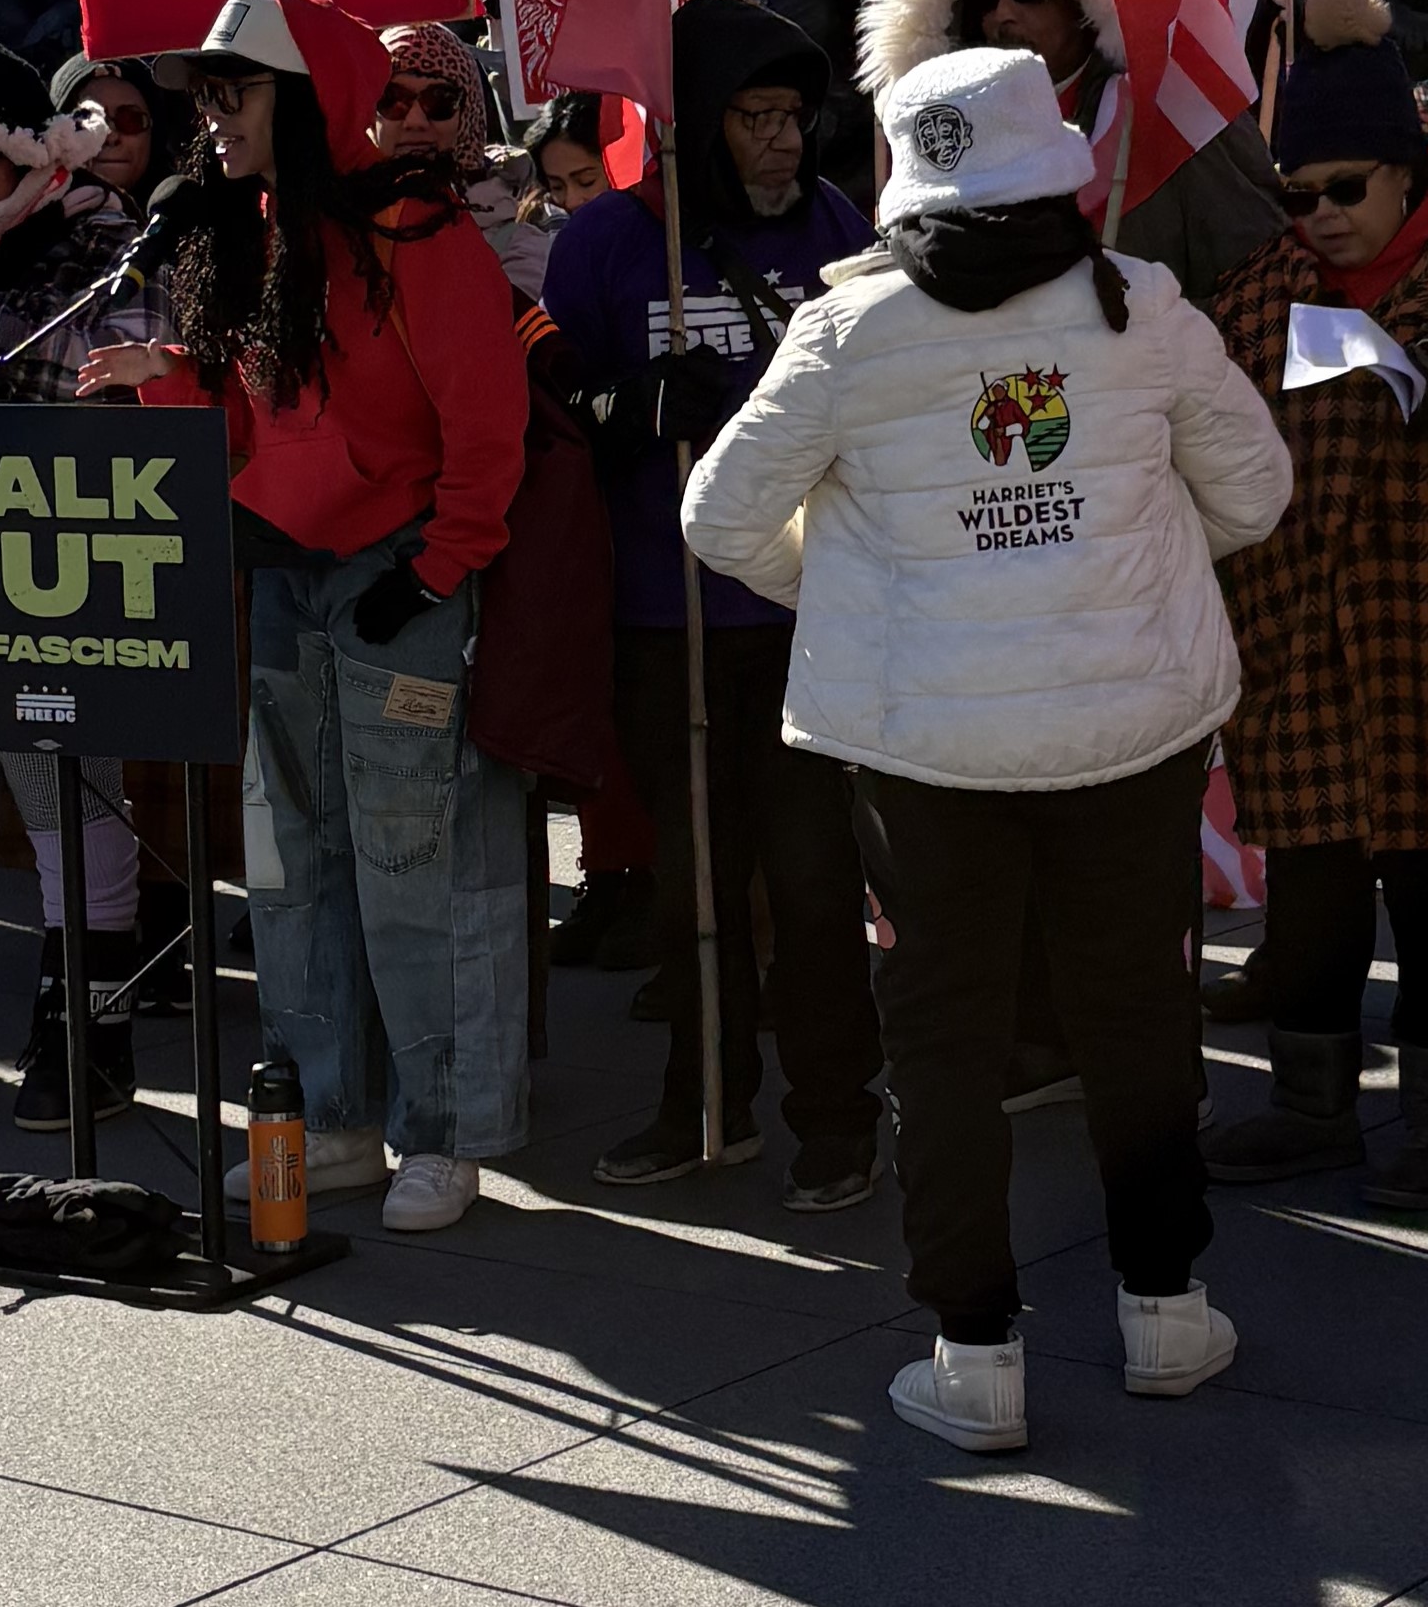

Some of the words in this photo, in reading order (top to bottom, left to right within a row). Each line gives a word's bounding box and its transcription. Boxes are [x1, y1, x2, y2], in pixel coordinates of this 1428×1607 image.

[973, 481, 1074, 505] HARRIET'S
[957, 498, 1085, 531] WILDEST
[976, 524, 1074, 551] DREAMS
[15, 708, 54, 722] FREE
[55, 709, 76, 723] DC
